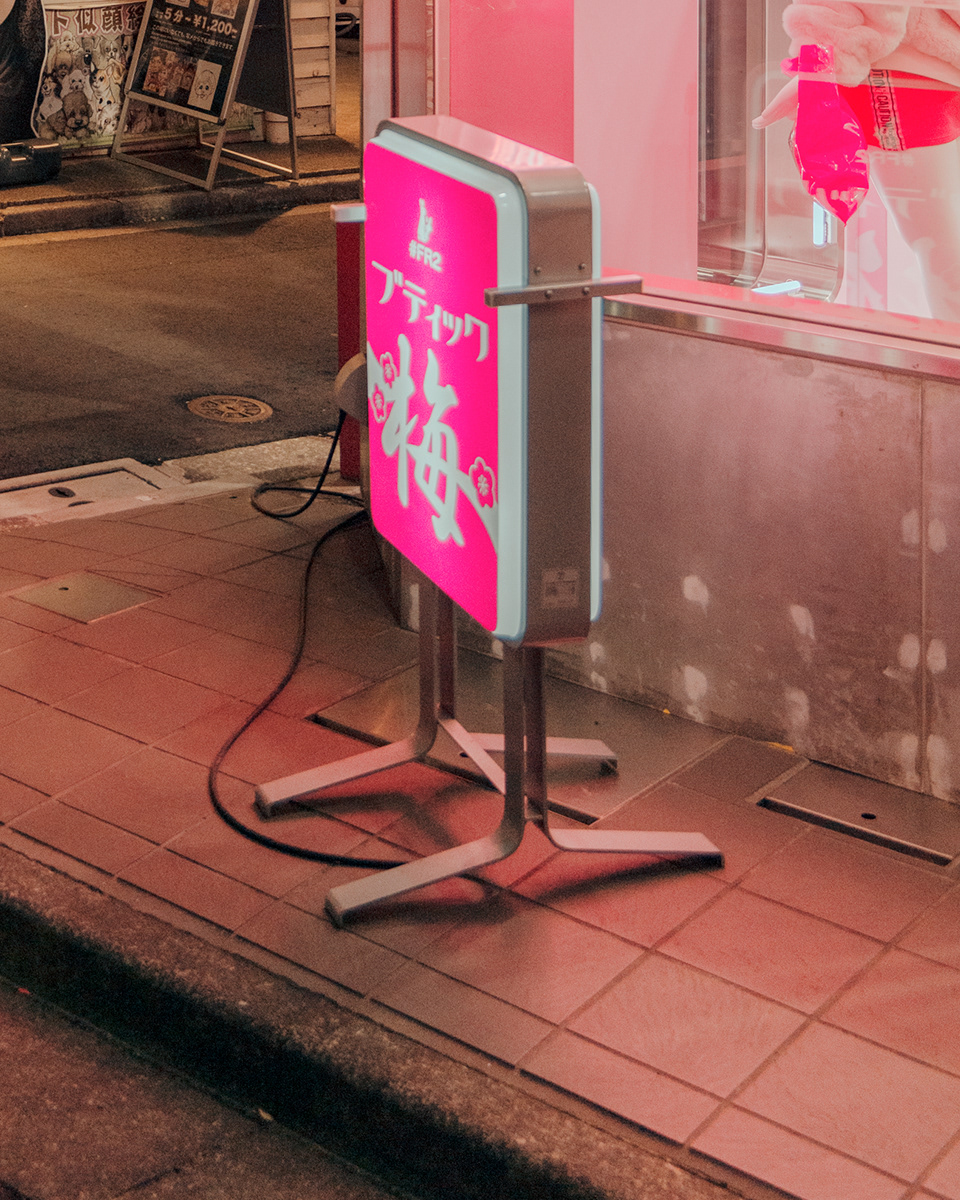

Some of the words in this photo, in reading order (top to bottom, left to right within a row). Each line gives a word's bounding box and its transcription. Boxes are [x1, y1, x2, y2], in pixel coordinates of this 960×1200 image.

[408, 238, 442, 273] #FR2
[371, 259, 490, 363] ブティック
[380, 332, 465, 548] 梅
